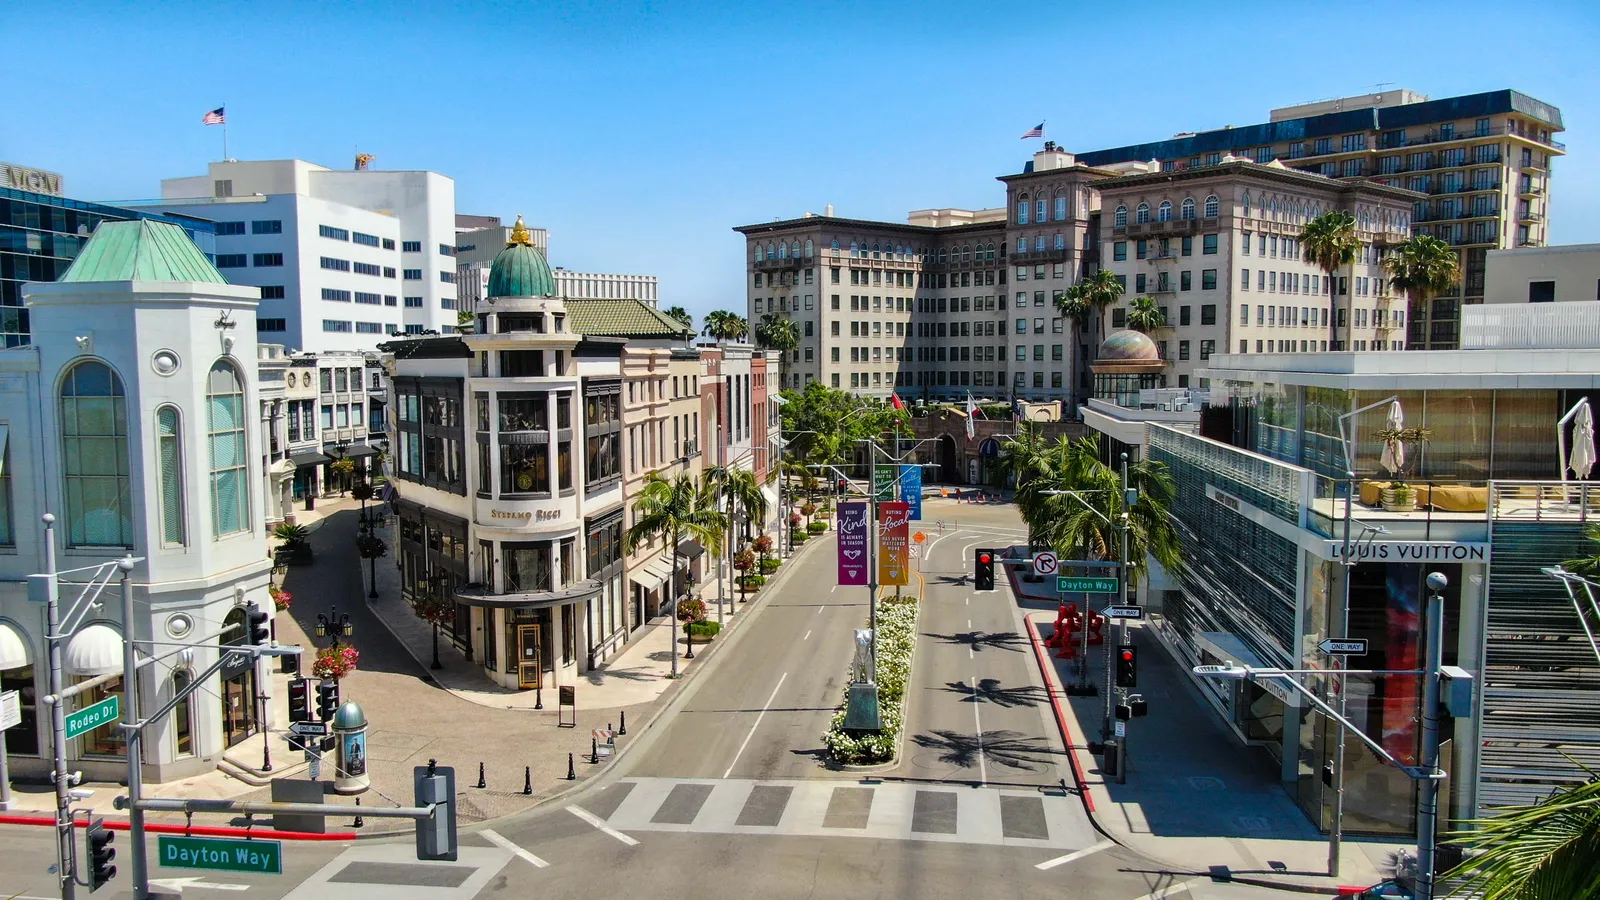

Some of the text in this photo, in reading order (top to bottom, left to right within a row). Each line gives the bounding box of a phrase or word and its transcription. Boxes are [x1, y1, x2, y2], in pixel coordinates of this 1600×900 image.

[837, 510, 868, 534] Kind
[879, 510, 909, 536] Local
[1332, 544, 1484, 560] LOUIS VUITTON
[1061, 581, 1113, 592] Dayton Way
[71, 705, 114, 732] Rodeo Dr
[167, 844, 271, 870] Dayton Way
